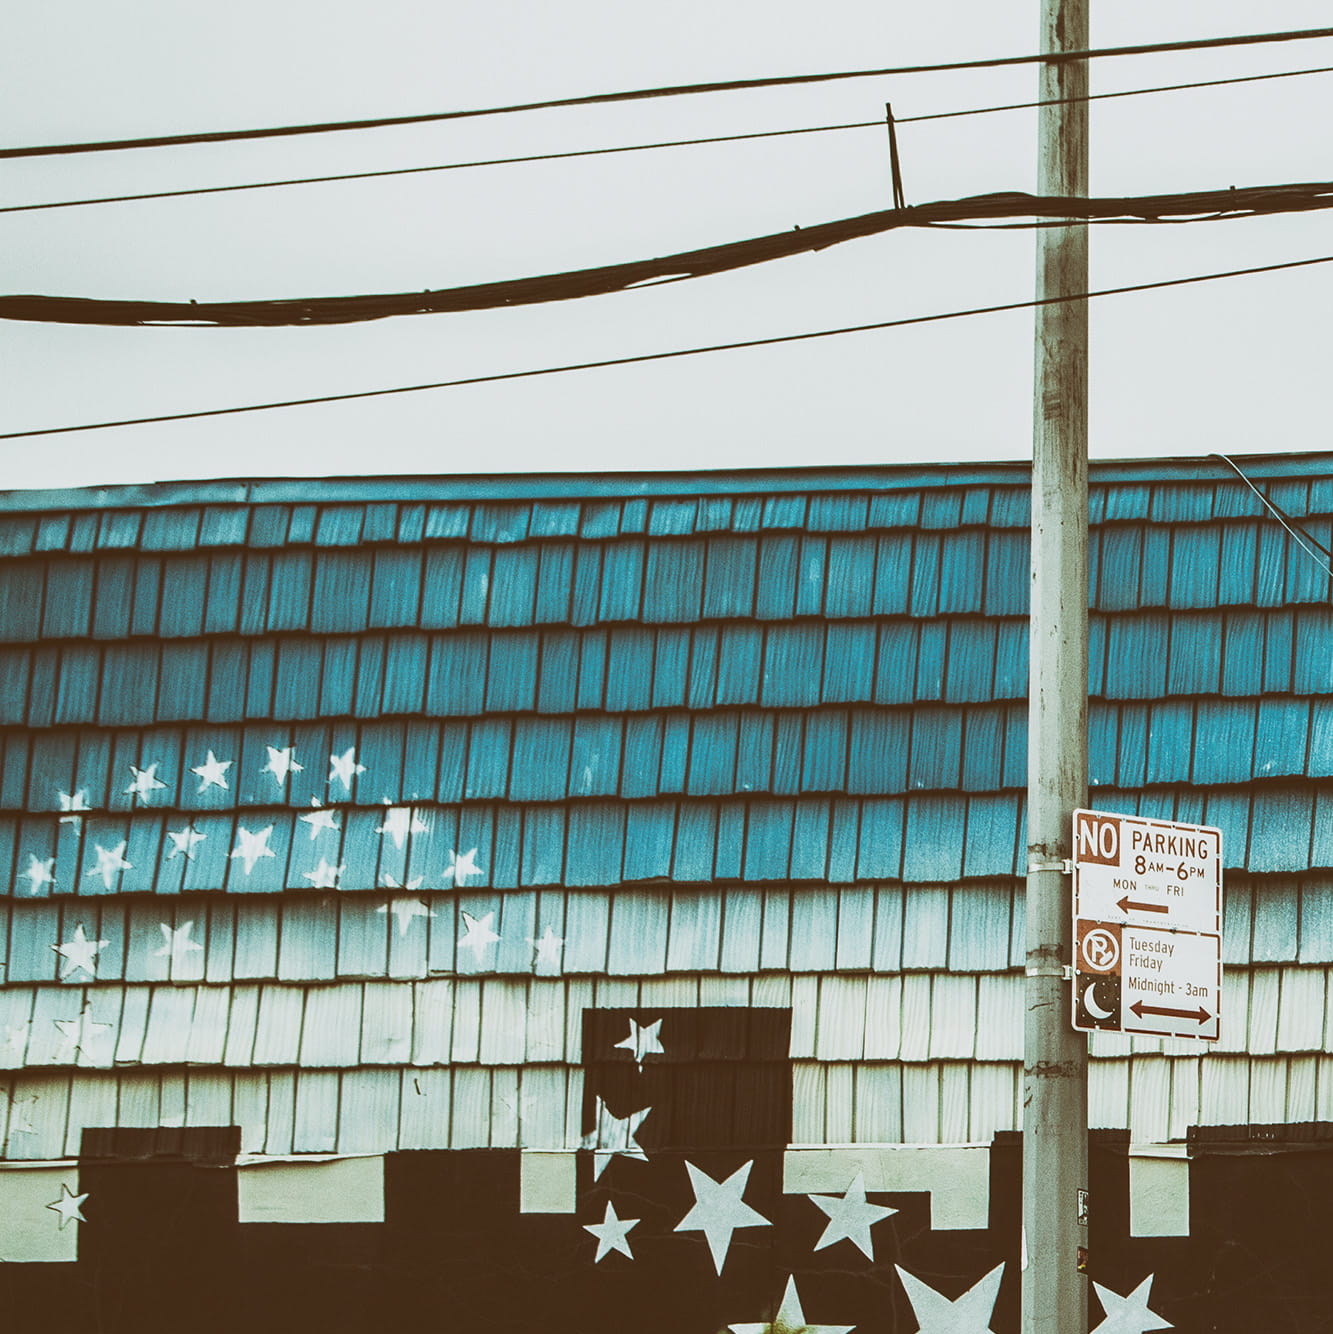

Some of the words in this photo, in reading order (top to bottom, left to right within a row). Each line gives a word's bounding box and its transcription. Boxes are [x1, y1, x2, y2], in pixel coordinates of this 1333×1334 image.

[1080, 819, 1118, 859] NO
[1132, 830, 1208, 860] PARKING
[1113, 878, 1137, 891] MON
[1166, 884, 1184, 897] FRI
[1129, 936, 1175, 958] Tuesday
[1129, 953, 1163, 972] Friday
[1128, 976, 1175, 996] Midnight
[1185, 982, 1208, 997] 3am
